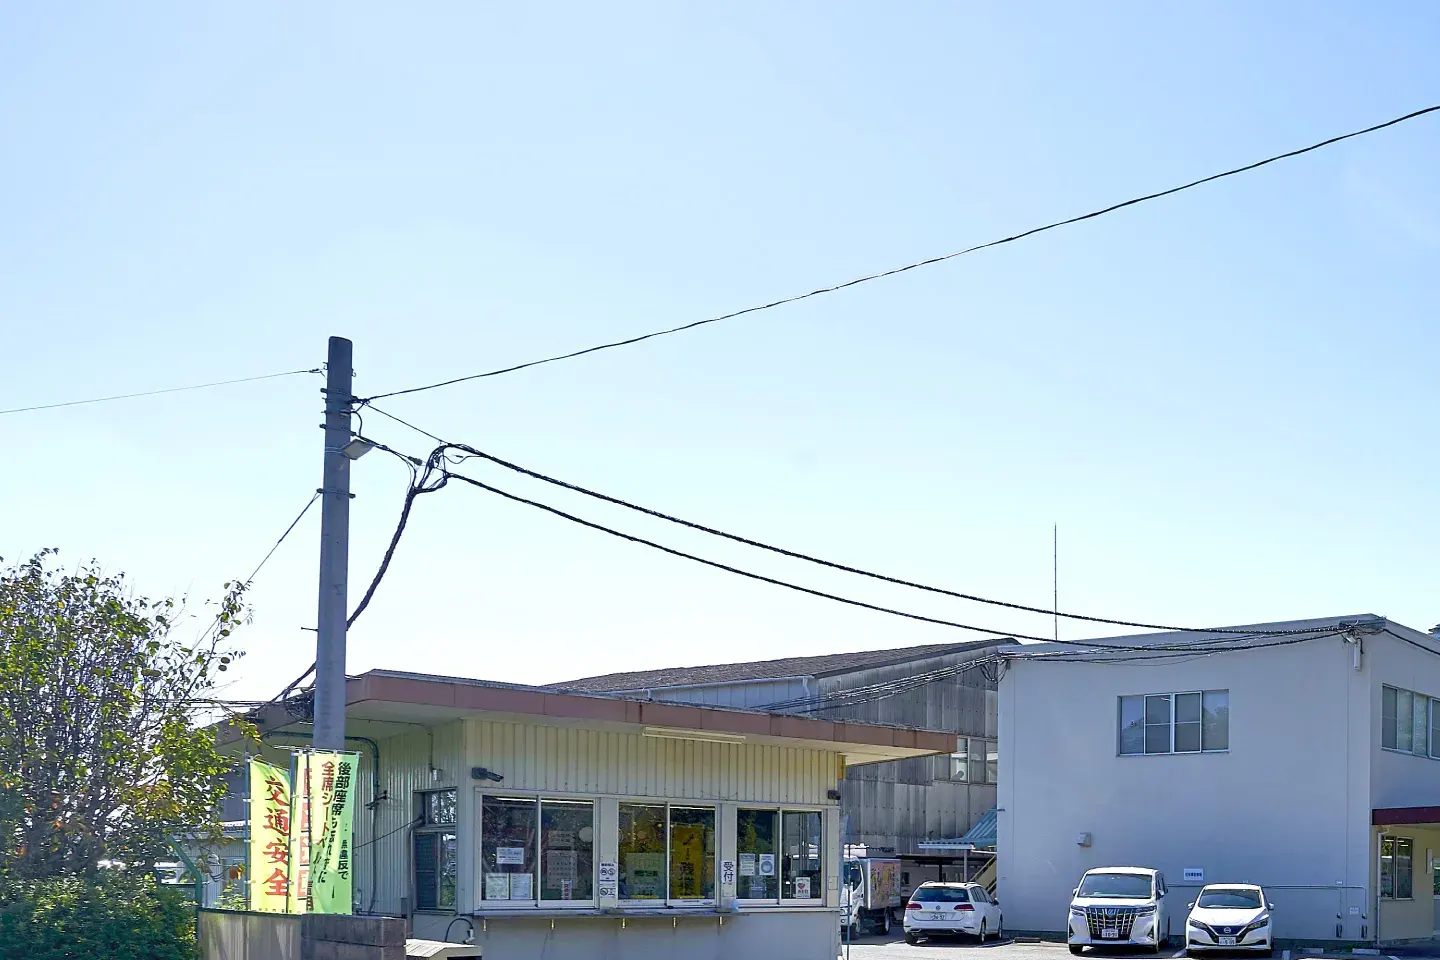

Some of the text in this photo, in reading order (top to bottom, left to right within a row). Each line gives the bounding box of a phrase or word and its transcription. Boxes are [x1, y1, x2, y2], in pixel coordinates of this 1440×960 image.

[262, 775, 292, 897] 交通安全
[723, 861, 735, 882] 受付
